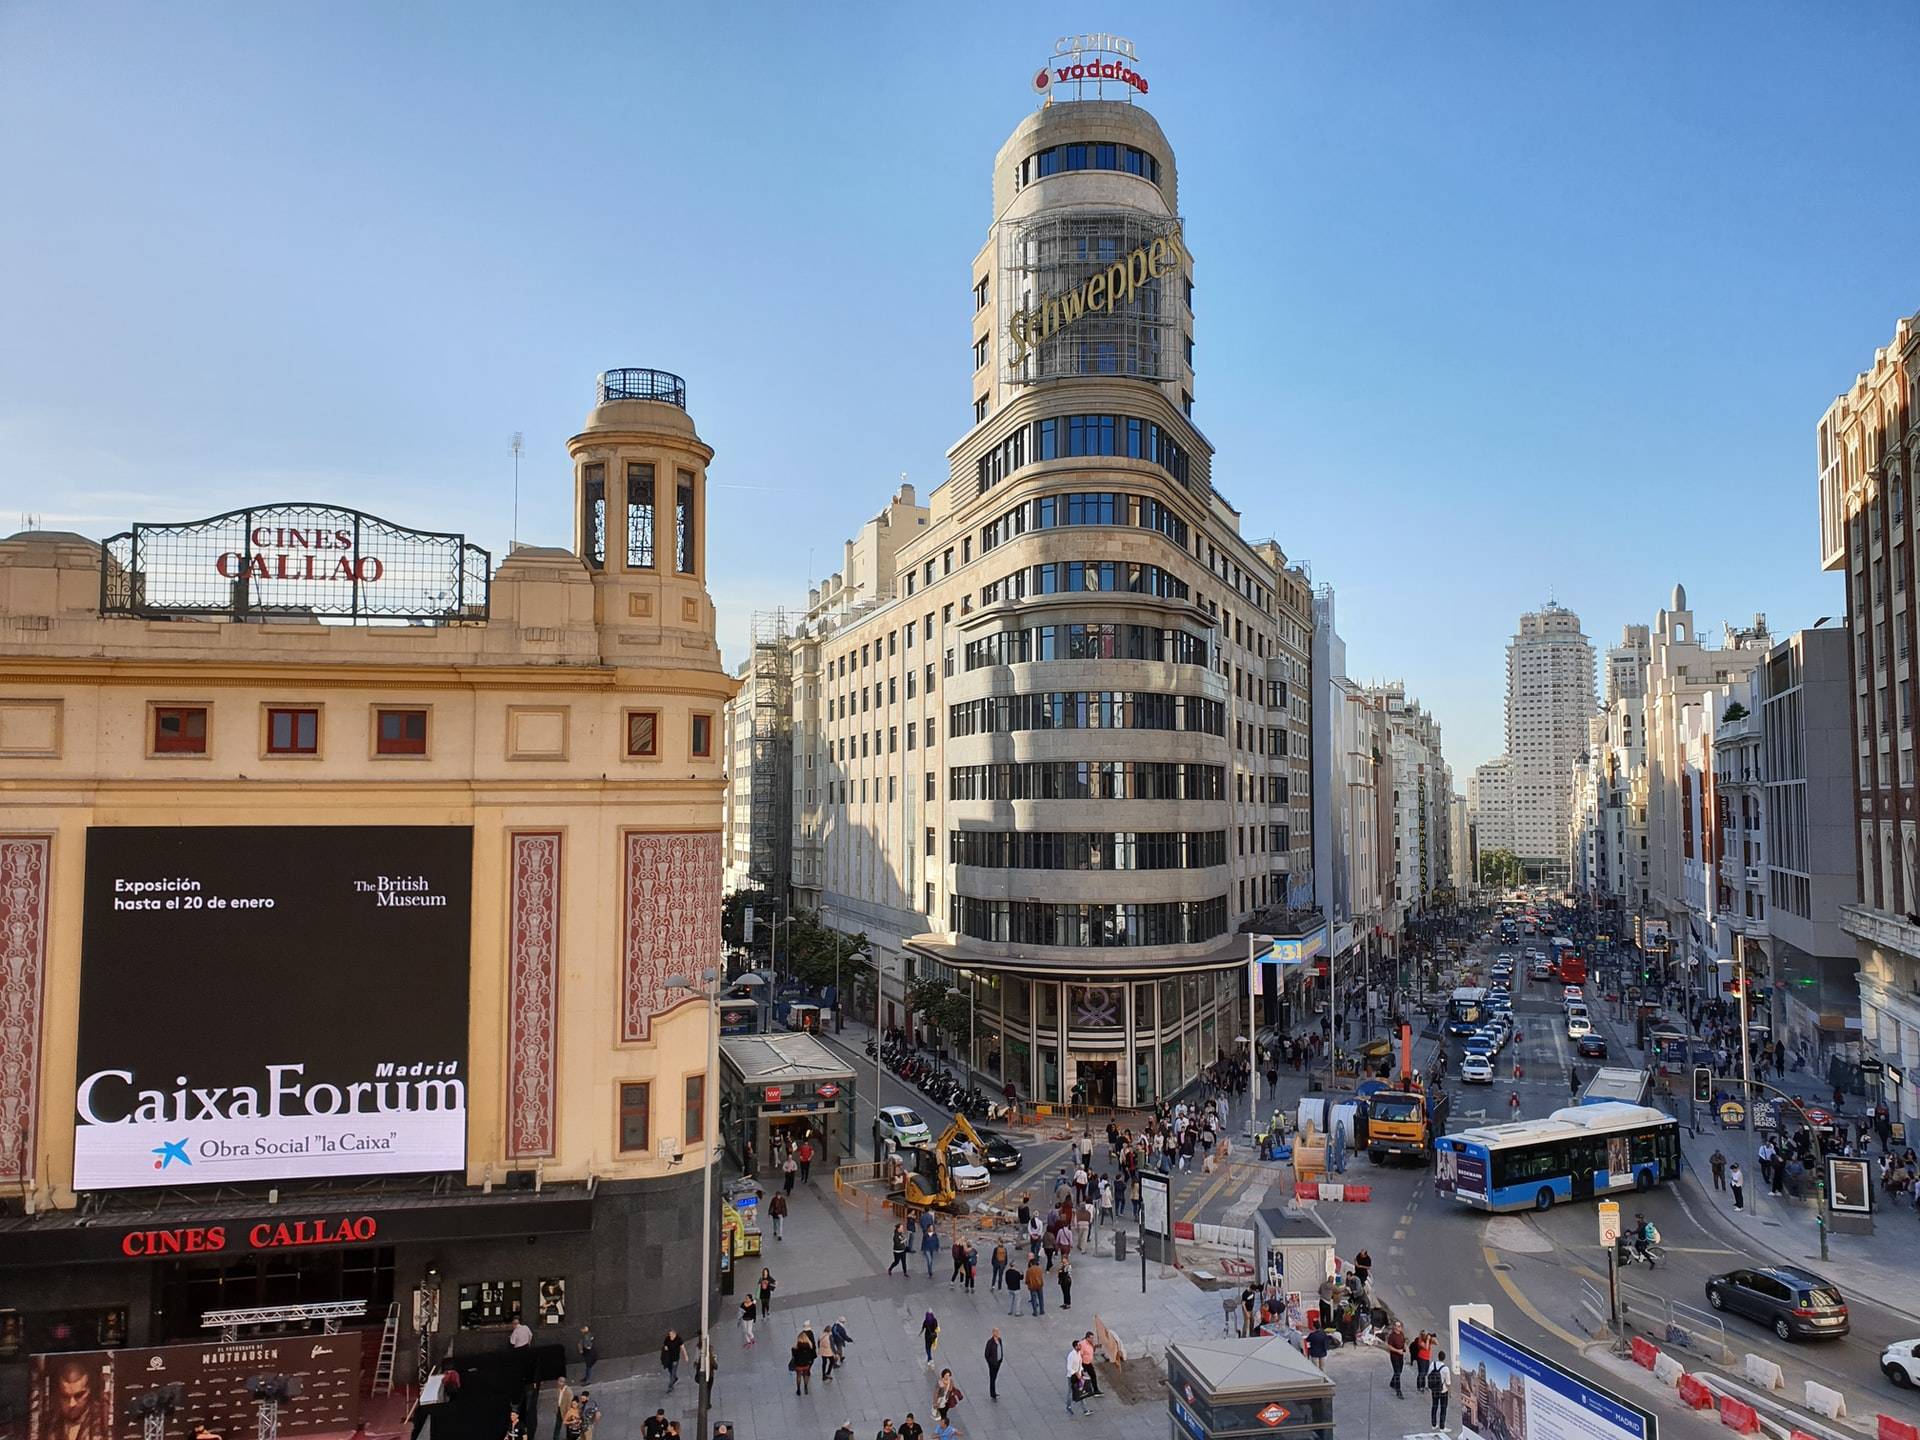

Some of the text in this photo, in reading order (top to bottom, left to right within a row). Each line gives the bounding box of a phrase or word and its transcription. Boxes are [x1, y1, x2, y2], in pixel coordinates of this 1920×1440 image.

[1057, 59, 1148, 94] vodafone
[1008, 222, 1184, 368] Schweppes
[252, 527, 352, 550] CINES
[216, 552, 383, 582] CALLAO
[115, 878, 200, 895] Exposición
[354, 876, 429, 891] The British
[114, 896, 275, 910] hasta el 20 de enero
[377, 892, 446, 906] Museum
[375, 1061, 457, 1077] Madrid
[76, 1063, 464, 1126] CaixaForum
[200, 1137, 250, 1158] Obra
[255, 1135, 309, 1154] Social
[122, 1216, 377, 1256] CINES CALLAO
[202, 1349, 278, 1364] MAUTHAUSEN
[1615, 1412, 1640, 1431] MADRID
